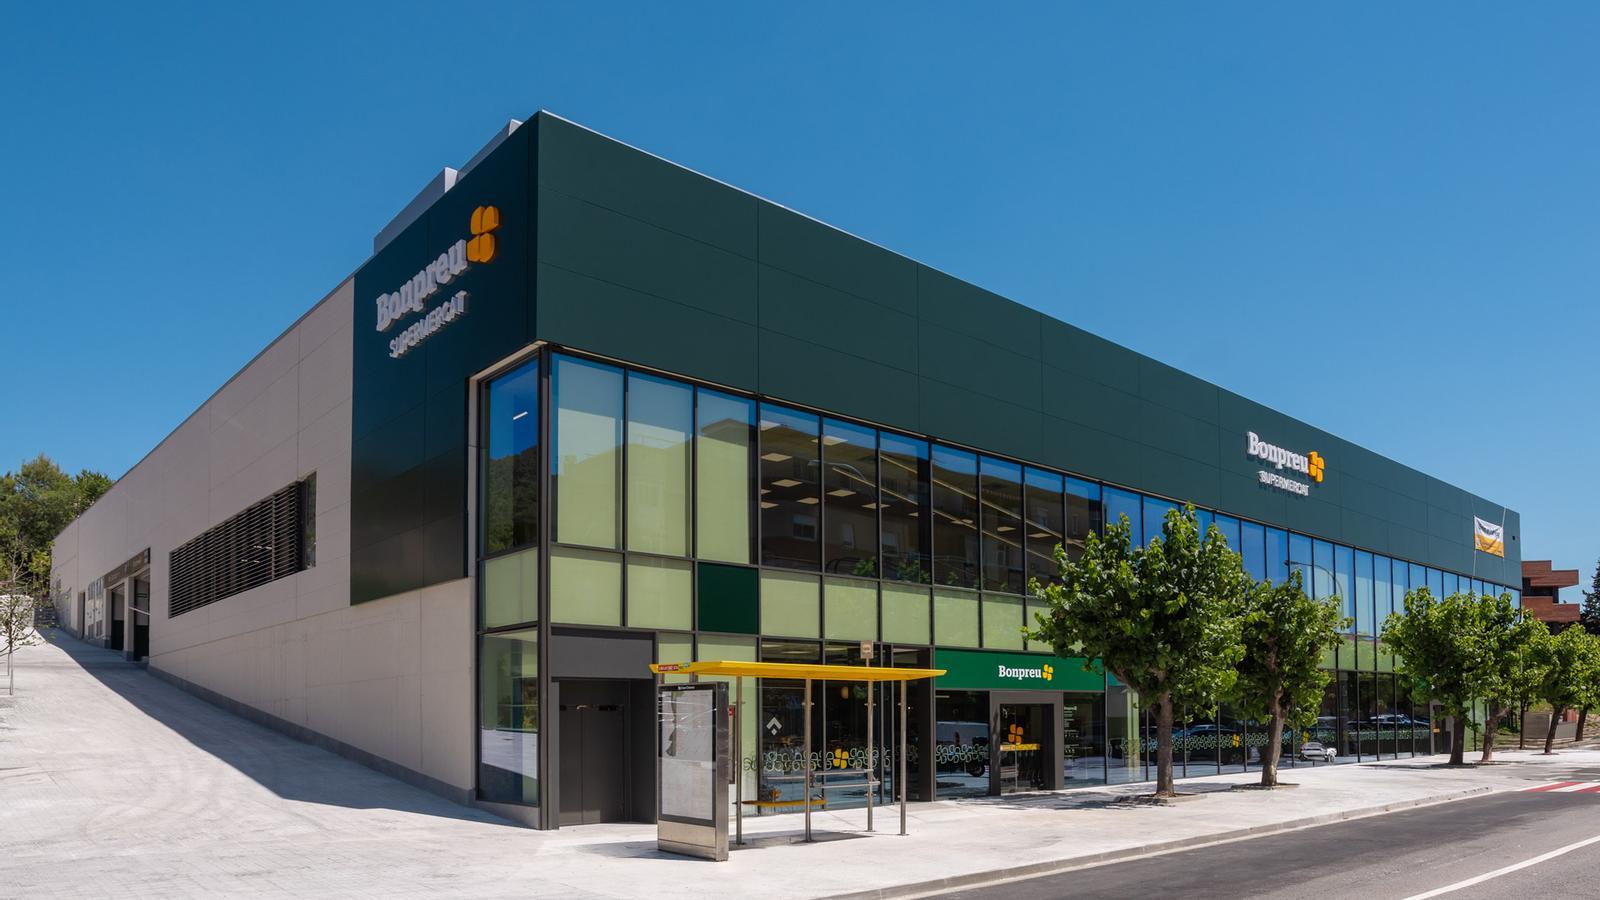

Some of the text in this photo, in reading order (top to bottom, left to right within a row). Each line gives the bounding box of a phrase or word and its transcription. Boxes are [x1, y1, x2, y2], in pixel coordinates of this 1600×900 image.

[376, 238, 468, 332] Bonpreu
[389, 290, 468, 359] SUPERMERCAT
[1247, 431, 1309, 474] Bonpreu
[1257, 470, 1310, 497] SUPERMERCAT
[998, 665, 1042, 681] Bonpreu
